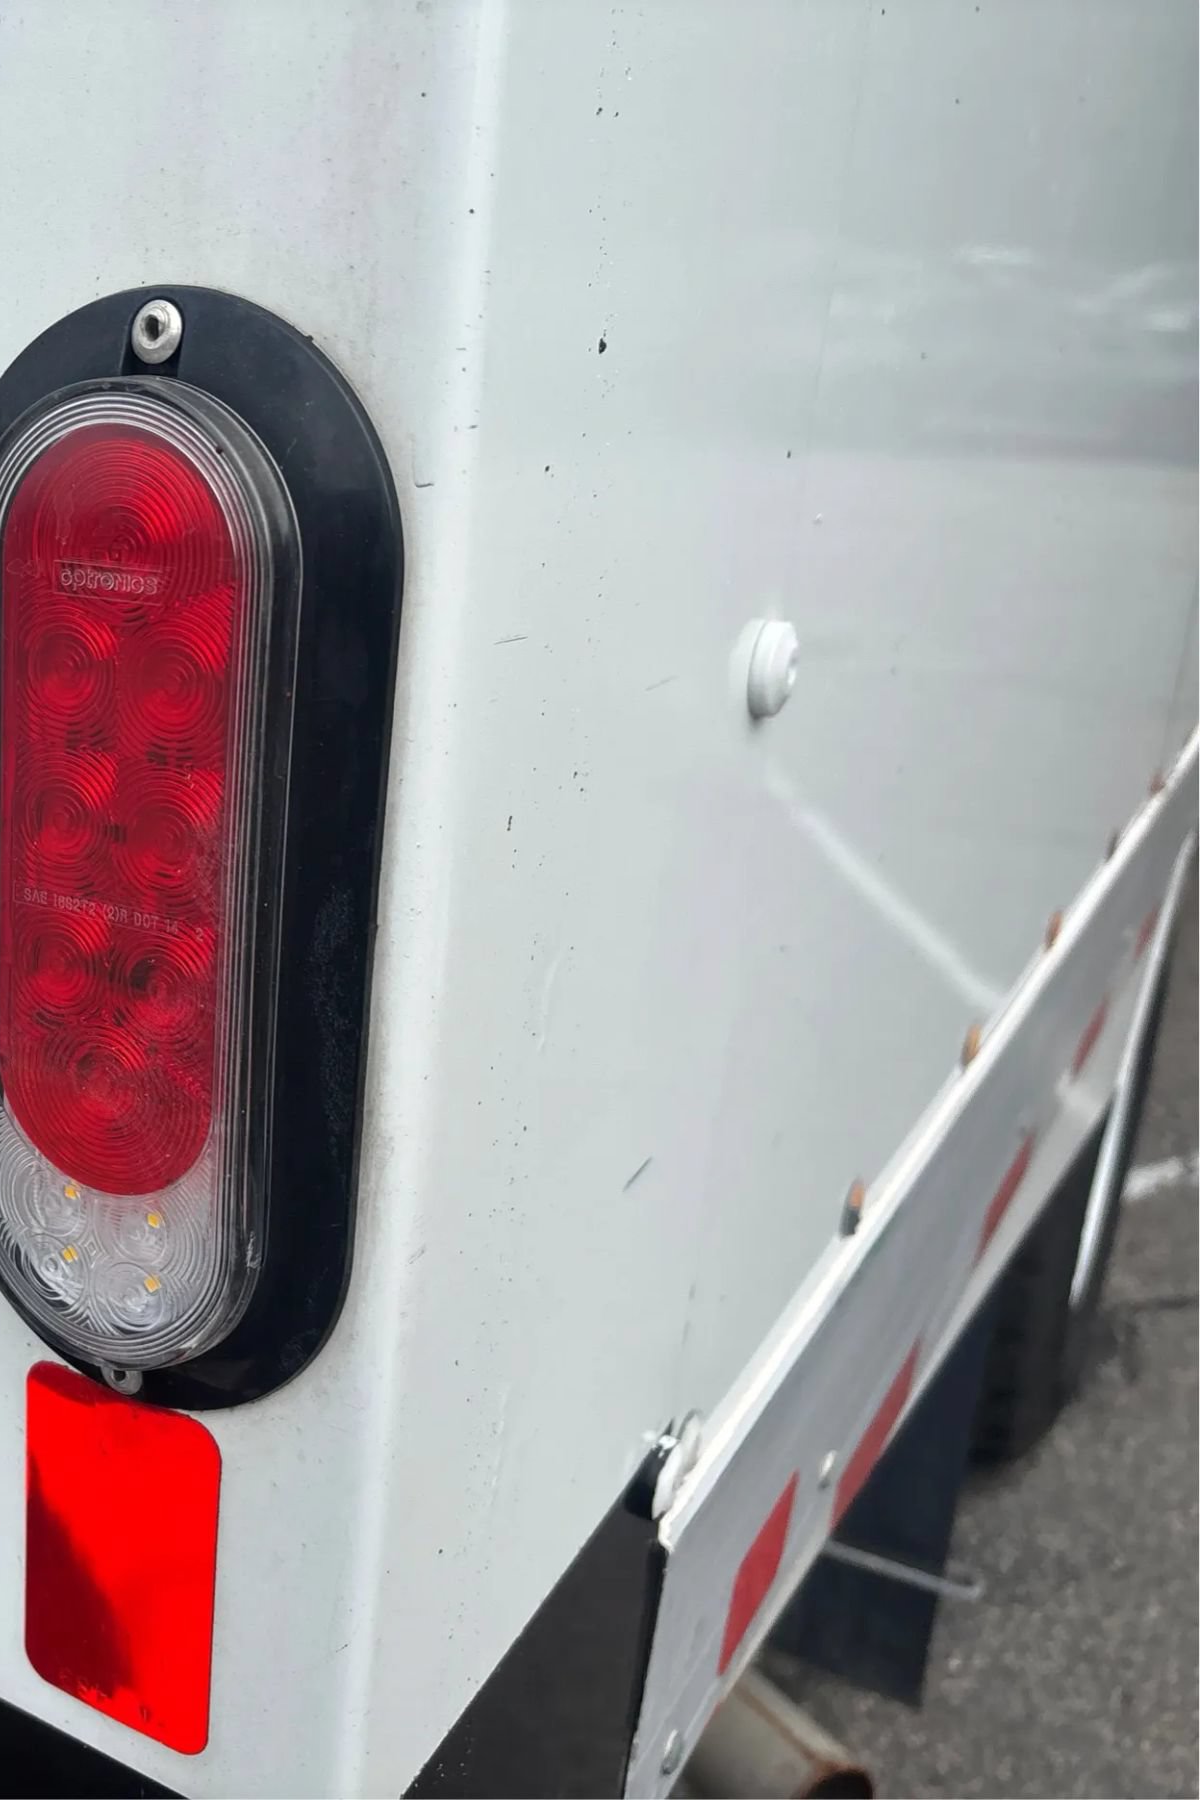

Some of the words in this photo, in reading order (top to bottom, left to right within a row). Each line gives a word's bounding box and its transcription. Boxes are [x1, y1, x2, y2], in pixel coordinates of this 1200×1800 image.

[60, 568, 159, 595] optronics
[23, 887, 48, 905] SAE
[133, 911, 159, 929] DOT
